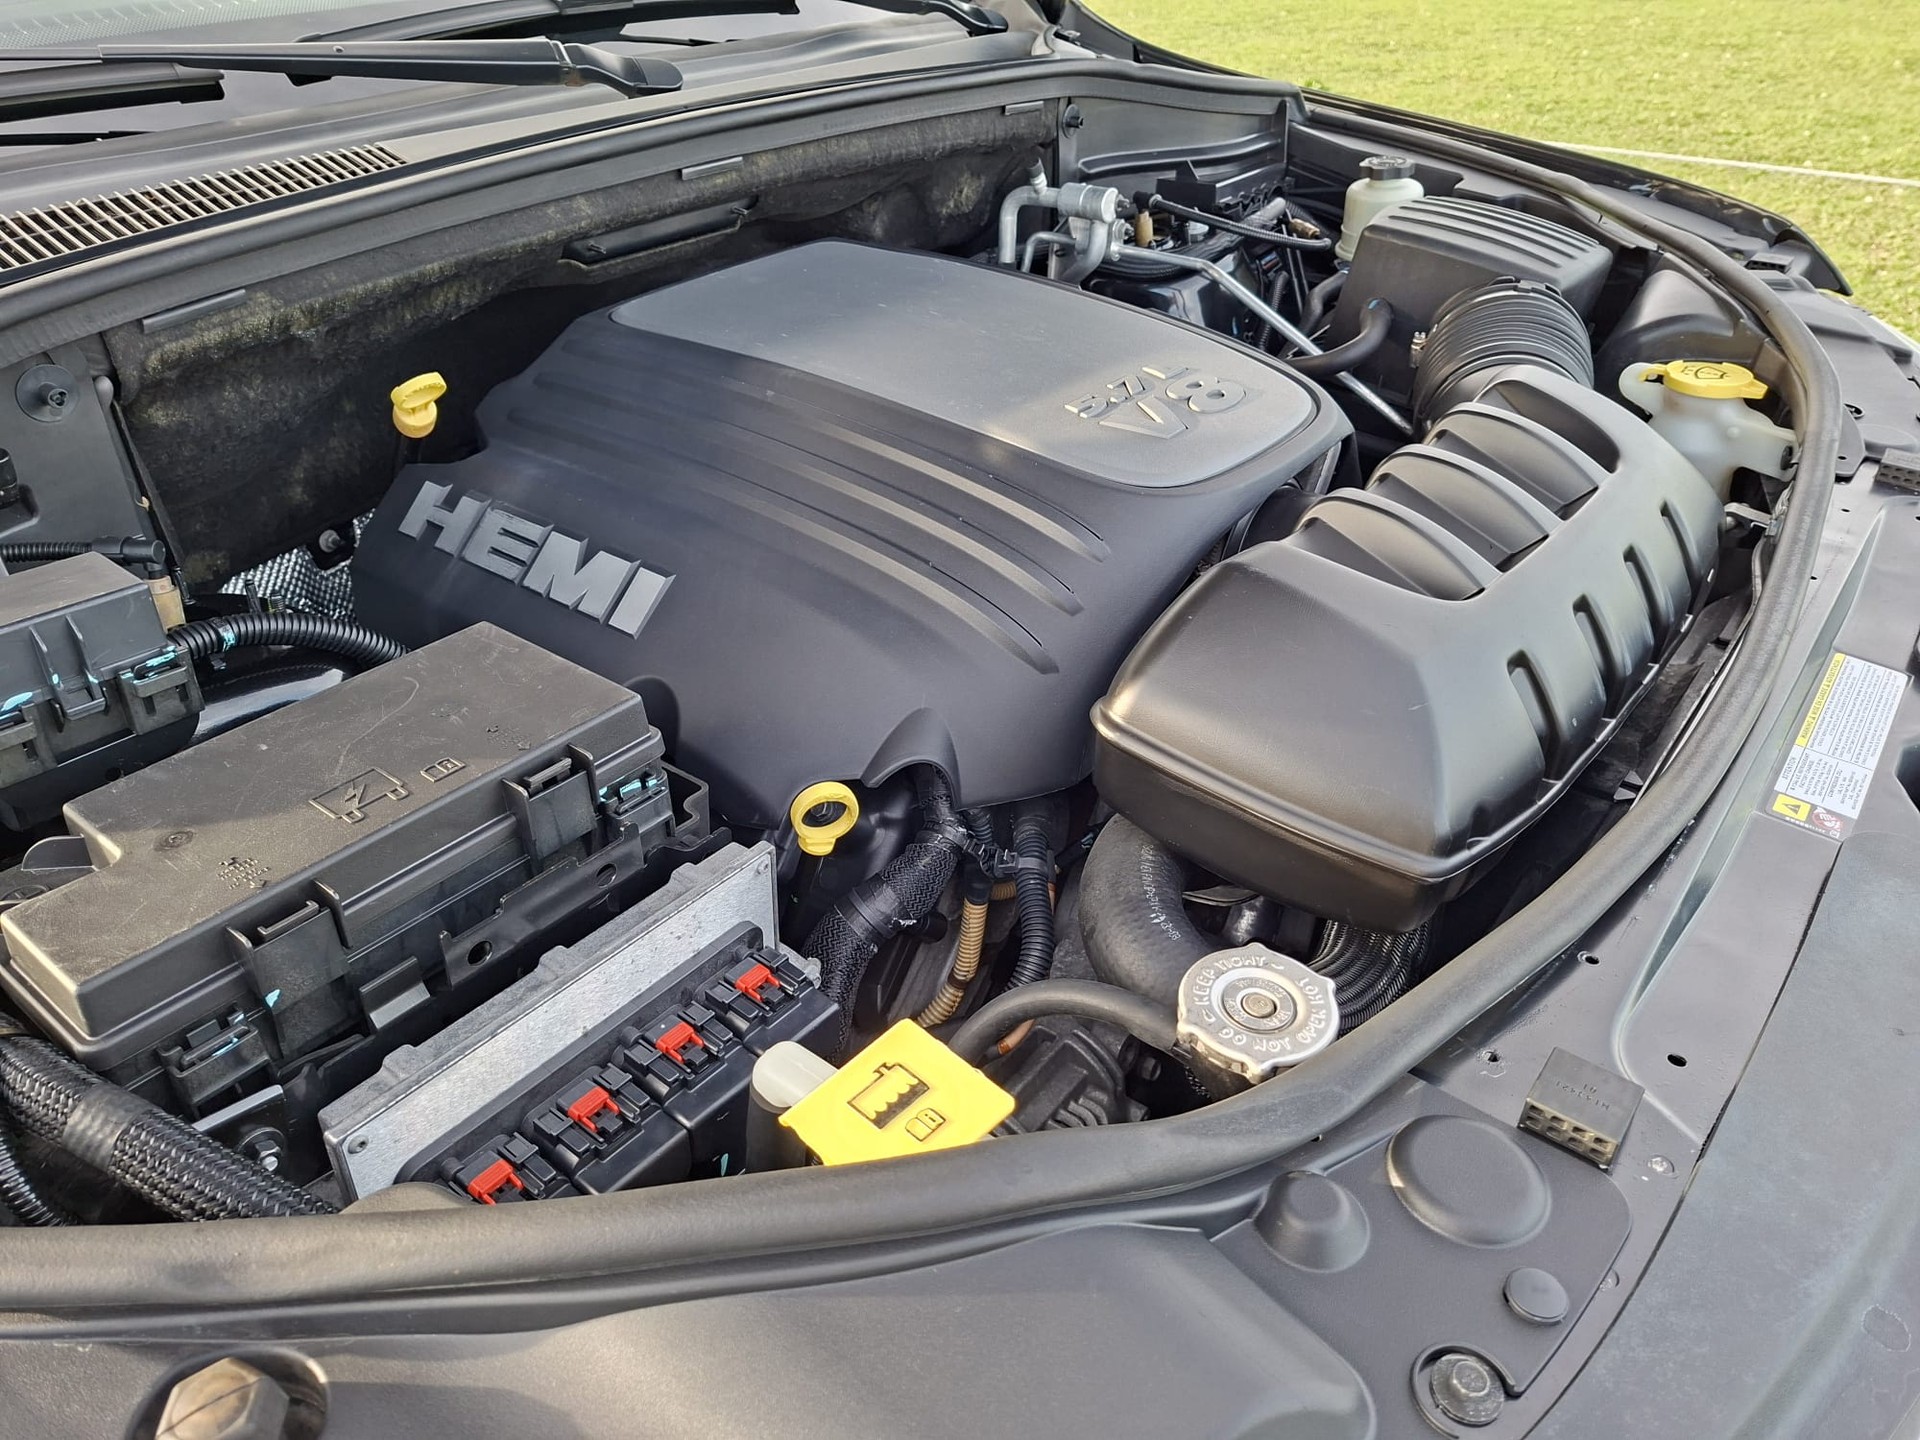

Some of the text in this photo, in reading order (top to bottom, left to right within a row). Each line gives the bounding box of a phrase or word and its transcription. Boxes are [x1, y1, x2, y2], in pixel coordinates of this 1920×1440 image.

[1099, 376, 1247, 440] V8
[398, 480, 677, 640] HEMI
[1192, 968, 1216, 1006] KEEP
